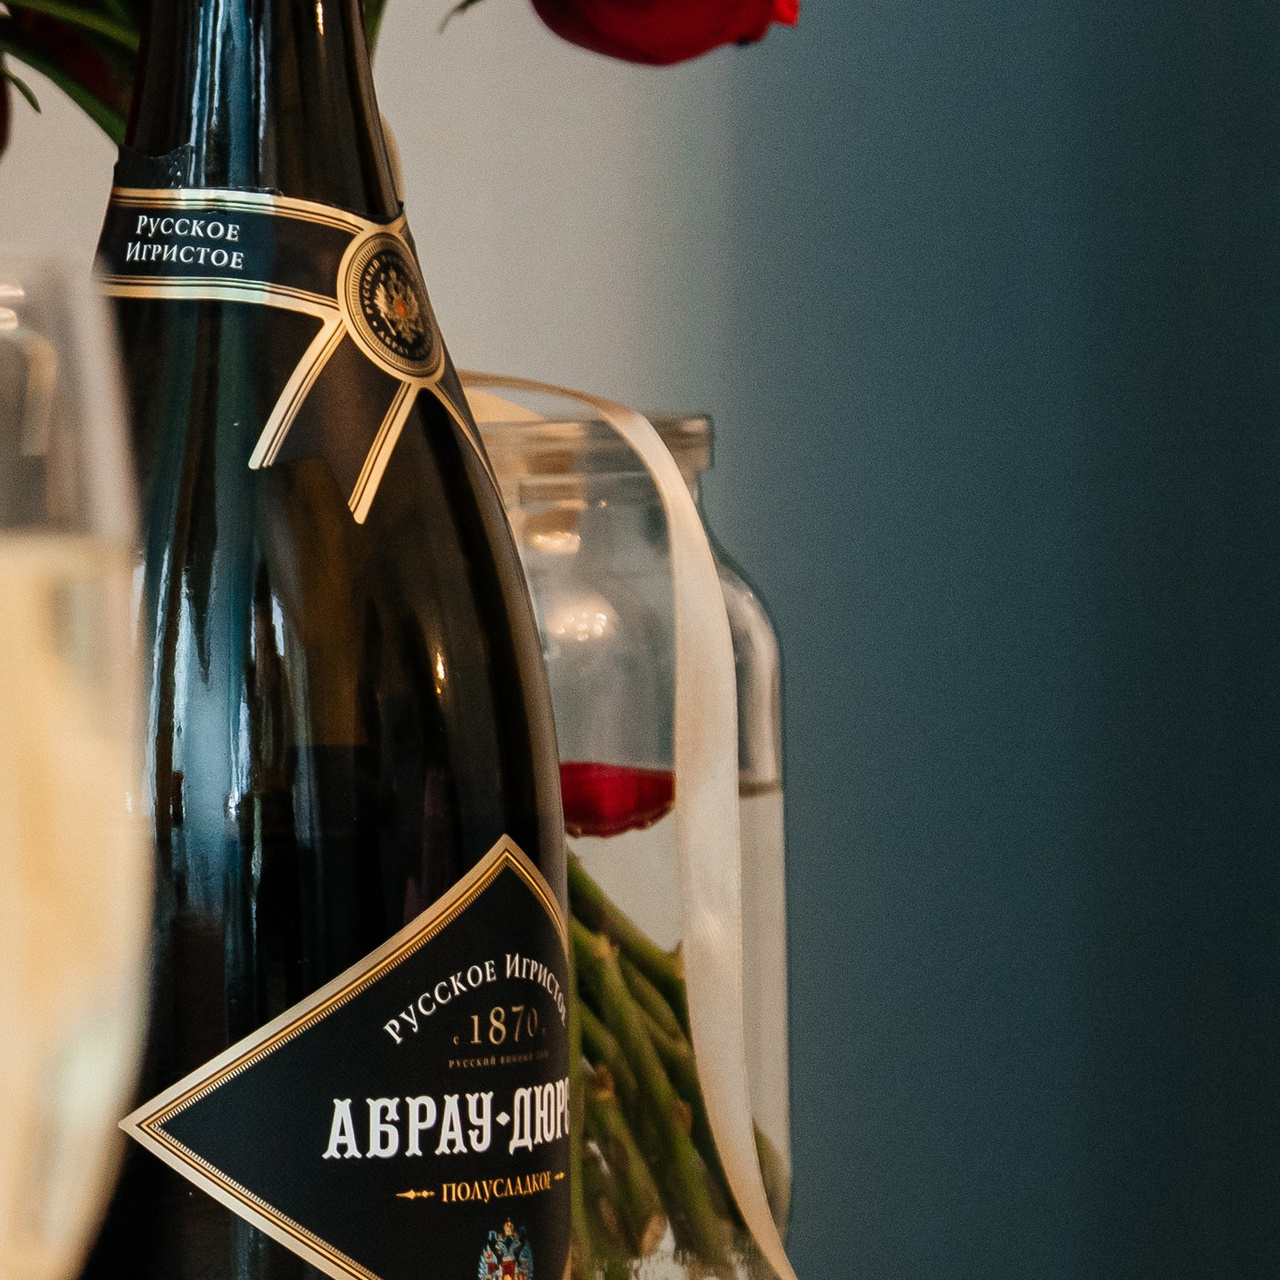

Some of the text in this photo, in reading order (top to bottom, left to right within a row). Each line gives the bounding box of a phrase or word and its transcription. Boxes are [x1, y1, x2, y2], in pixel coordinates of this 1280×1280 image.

[135, 214, 240, 242] РУССКОЕ
[125, 240, 244, 270] ИГРИСТОЕ
[383, 959, 497, 1045] РУССКОЕ
[470, 1004, 538, 1046] 1870
